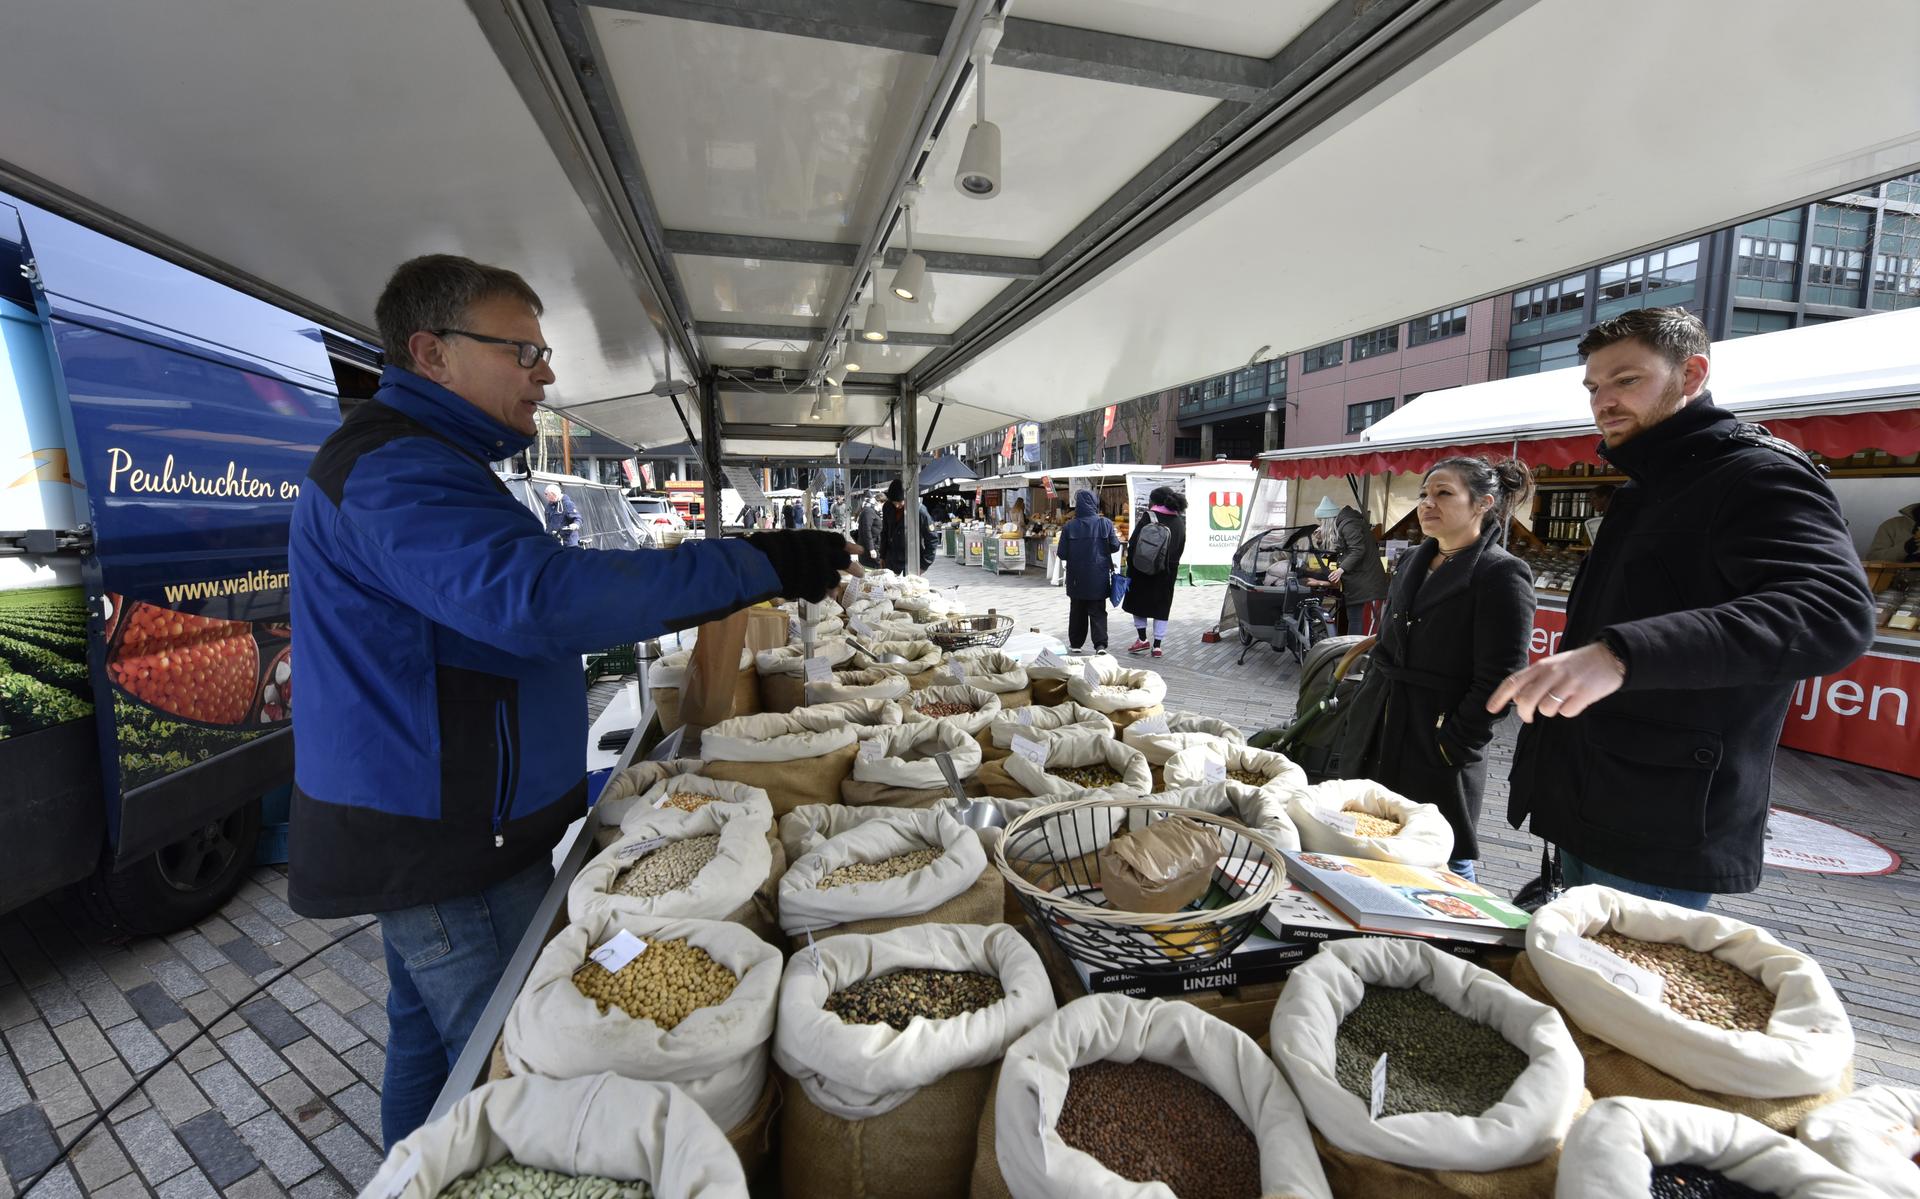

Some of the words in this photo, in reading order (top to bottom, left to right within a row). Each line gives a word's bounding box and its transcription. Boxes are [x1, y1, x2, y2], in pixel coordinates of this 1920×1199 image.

[107, 448, 275, 498] Peulvruchten
[280, 481, 299, 499] en
[1208, 534, 1241, 542] HOLLAND
[1293, 930, 1309, 938] JOKE
[1310, 931, 1329, 939] BOON
[1102, 975, 1120, 983] JOKE
[1183, 973, 1237, 991] LINZEN!
[1125, 987, 1146, 995] BOON
